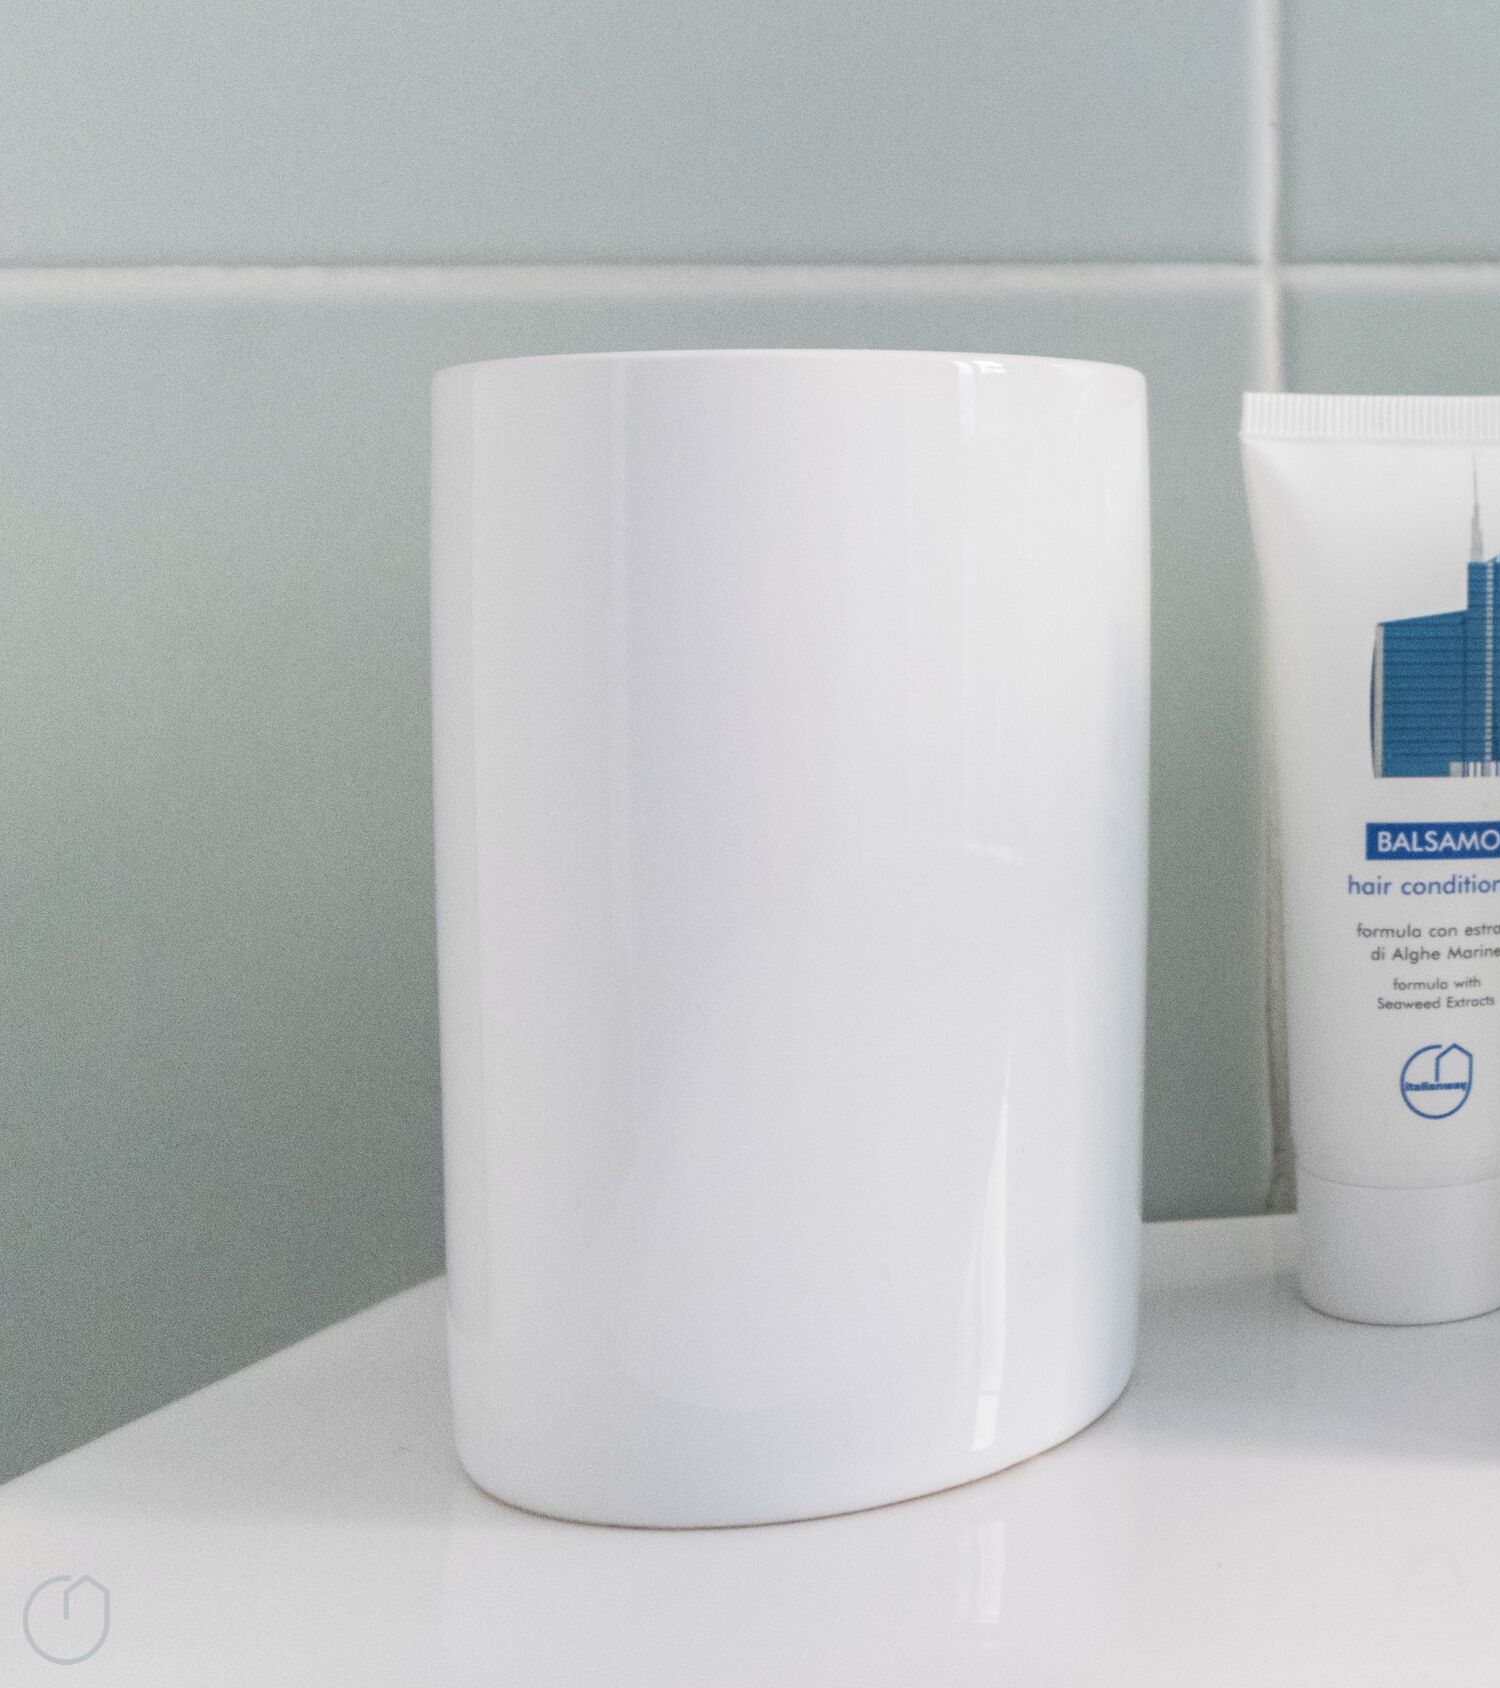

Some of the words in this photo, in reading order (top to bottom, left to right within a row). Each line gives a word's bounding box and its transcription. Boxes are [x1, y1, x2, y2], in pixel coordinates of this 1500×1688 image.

[1347, 874, 1392, 896] hair
[1356, 922, 1422, 939] formula
[1428, 925, 1458, 938] con
[1371, 946, 1385, 961] di
[1391, 947, 1441, 965] Alghe
[1392, 977, 1449, 991] formula
[1453, 976, 1482, 989] with
[1377, 997, 1441, 1011] Seaweed
[1446, 995, 1496, 1008] Extracts
